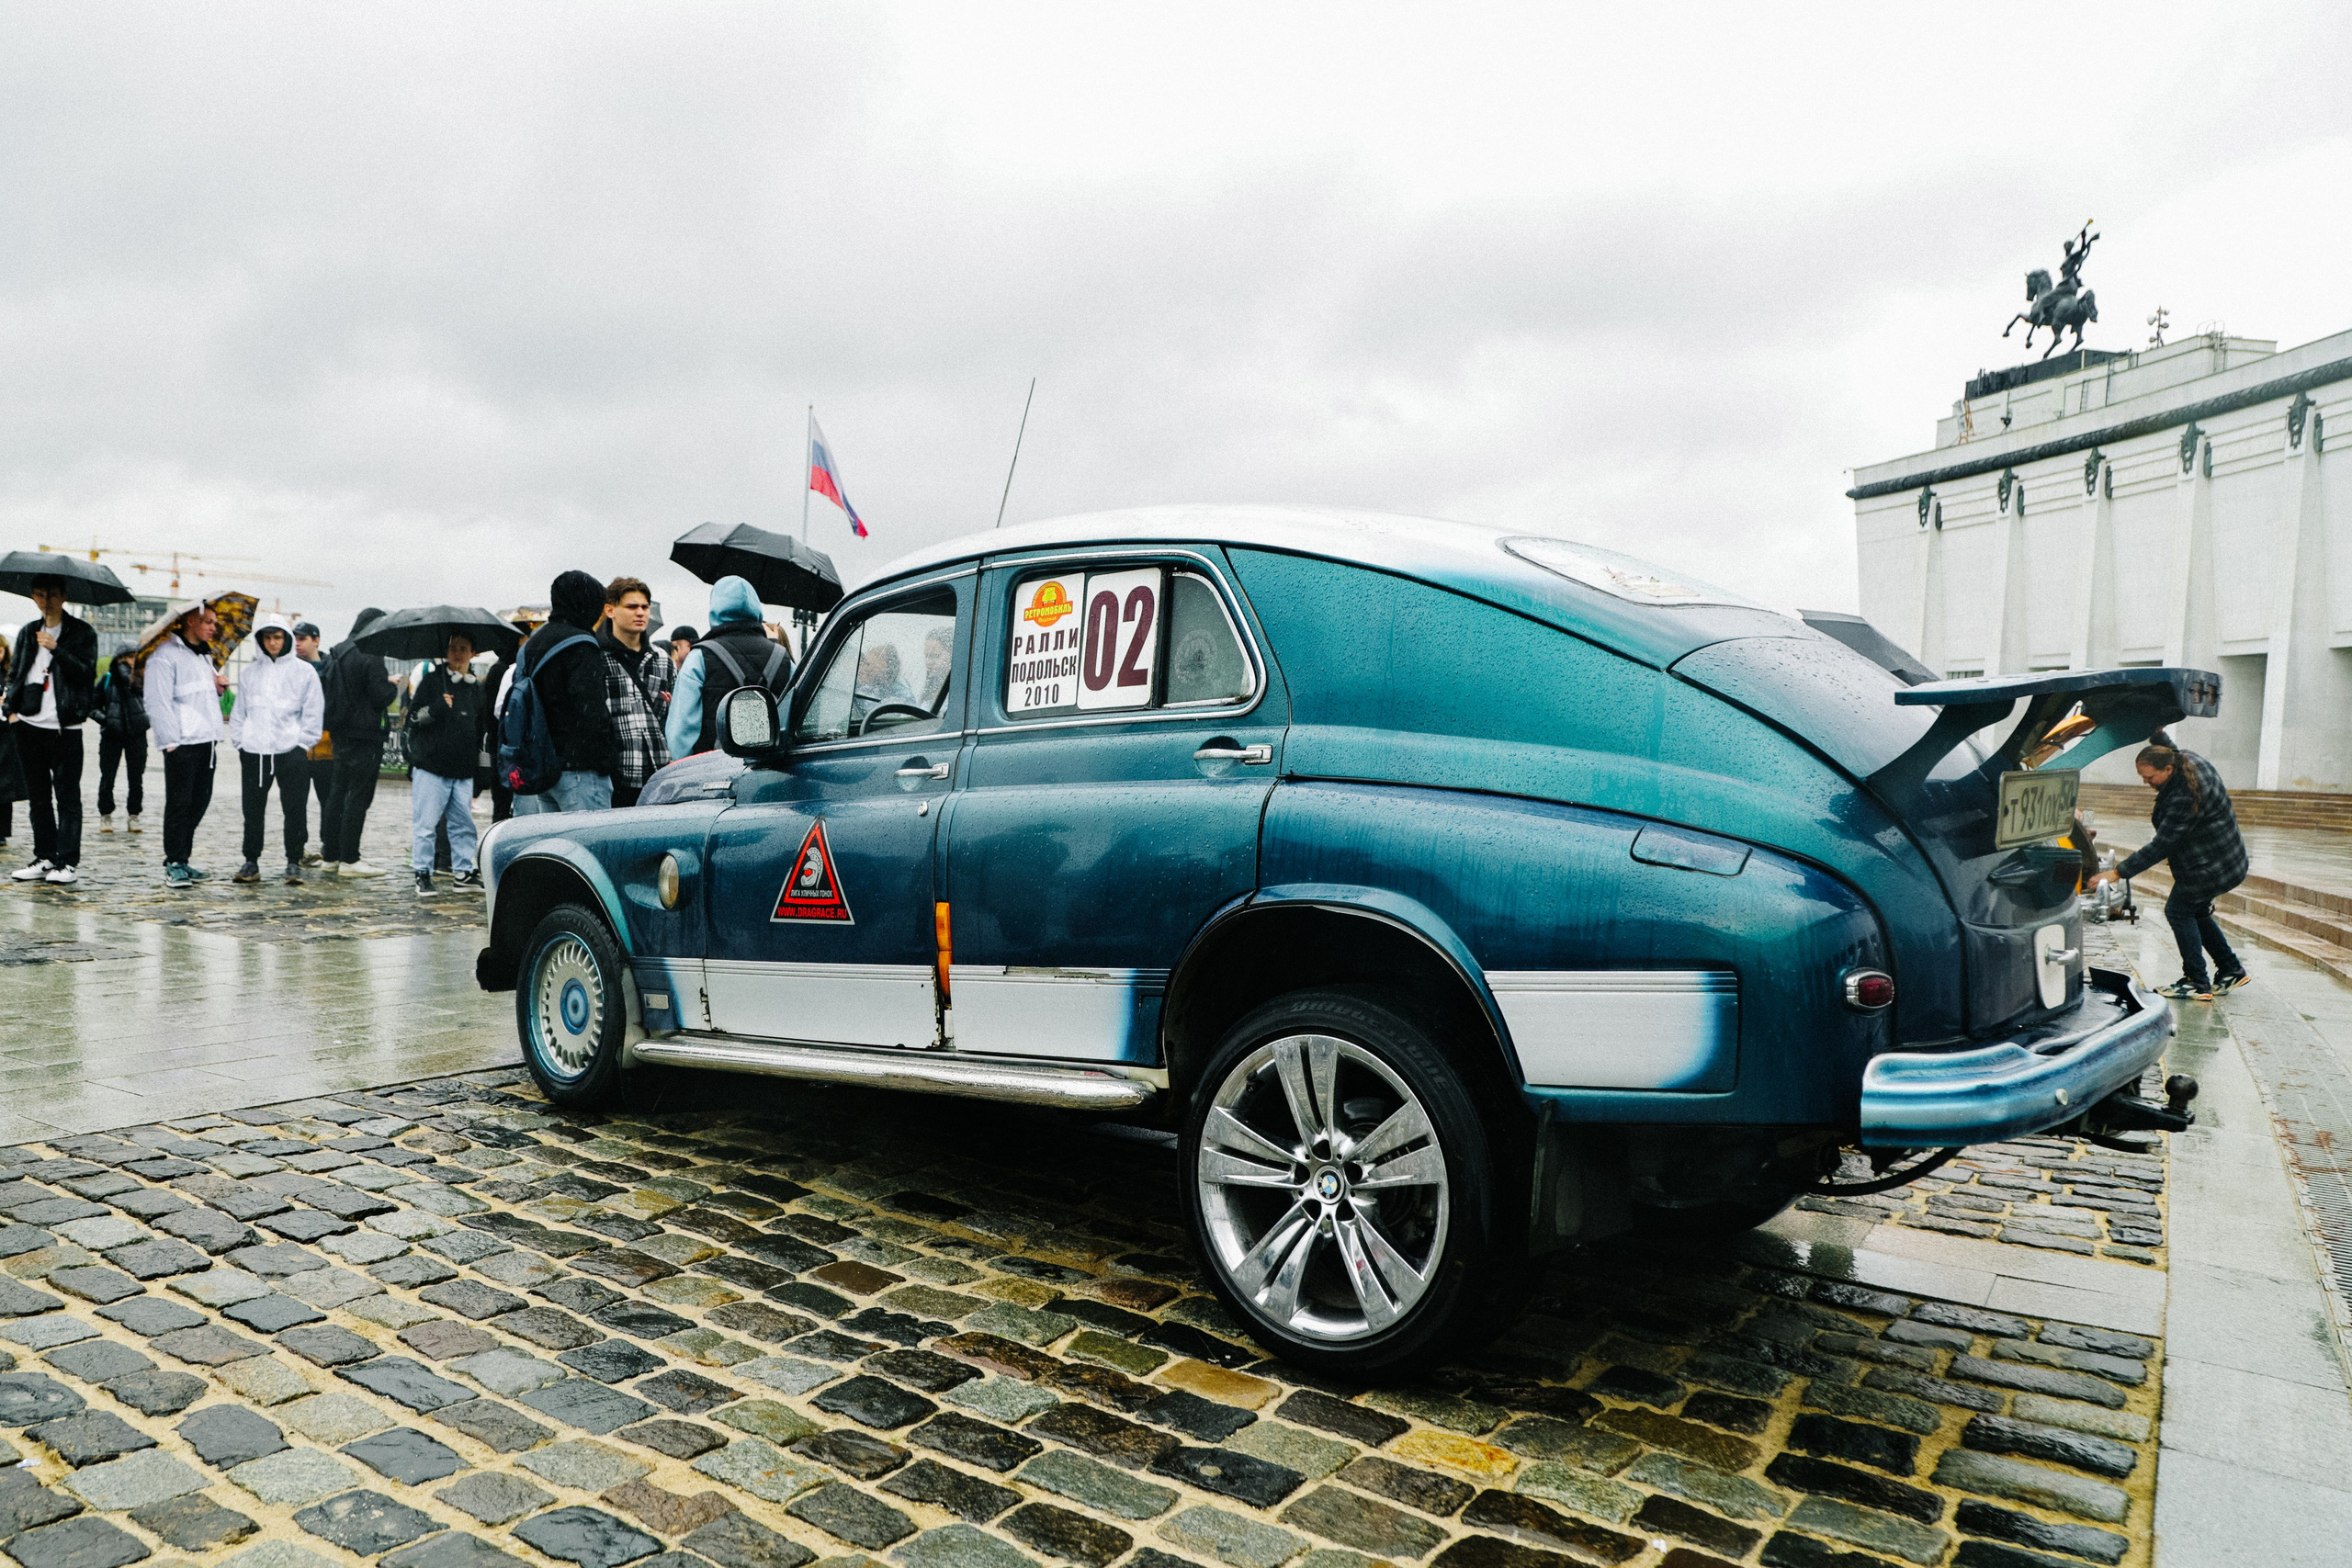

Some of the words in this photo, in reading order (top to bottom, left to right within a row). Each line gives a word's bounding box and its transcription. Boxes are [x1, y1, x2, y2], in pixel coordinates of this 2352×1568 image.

[1024, 604, 1072, 619] РЕТРОМОБИЛЬ
[1013, 627, 1079, 657] РАЛЛИ
[1083, 585, 1155, 692] 02
[1012, 655, 1077, 685] ПОДОЛЬСК
[1024, 683, 1059, 707] 2010
[801, 889, 820, 897] УЛИЧНЫХ
[777, 907, 847, 919] WWW.DRAGRACE.RU
